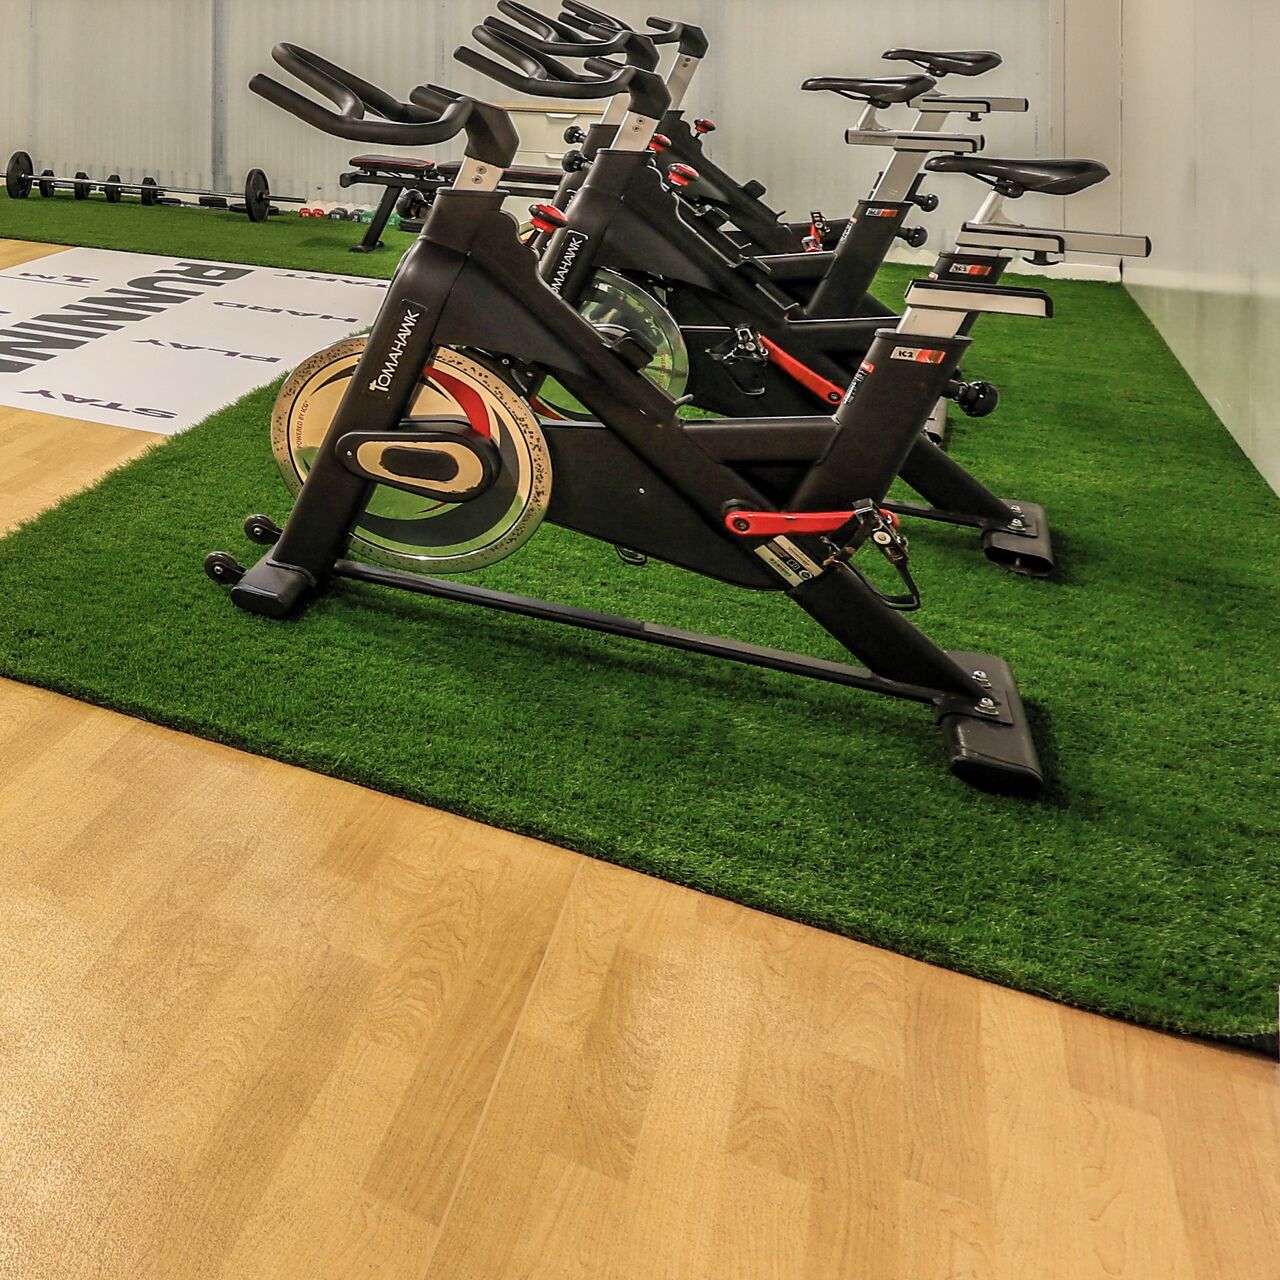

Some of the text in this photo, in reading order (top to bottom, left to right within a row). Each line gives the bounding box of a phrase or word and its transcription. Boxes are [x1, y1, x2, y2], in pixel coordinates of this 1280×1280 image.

[551, 237, 583, 295] OMAHAWK
[273, 274, 390, 288] TART
[212, 301, 359, 322] HARD
[132, 339, 282, 363] PLAY
[369, 309, 420, 392] TOMAHAWK
[898, 350, 914, 358] IC2
[16, 389, 180, 420] STAY
